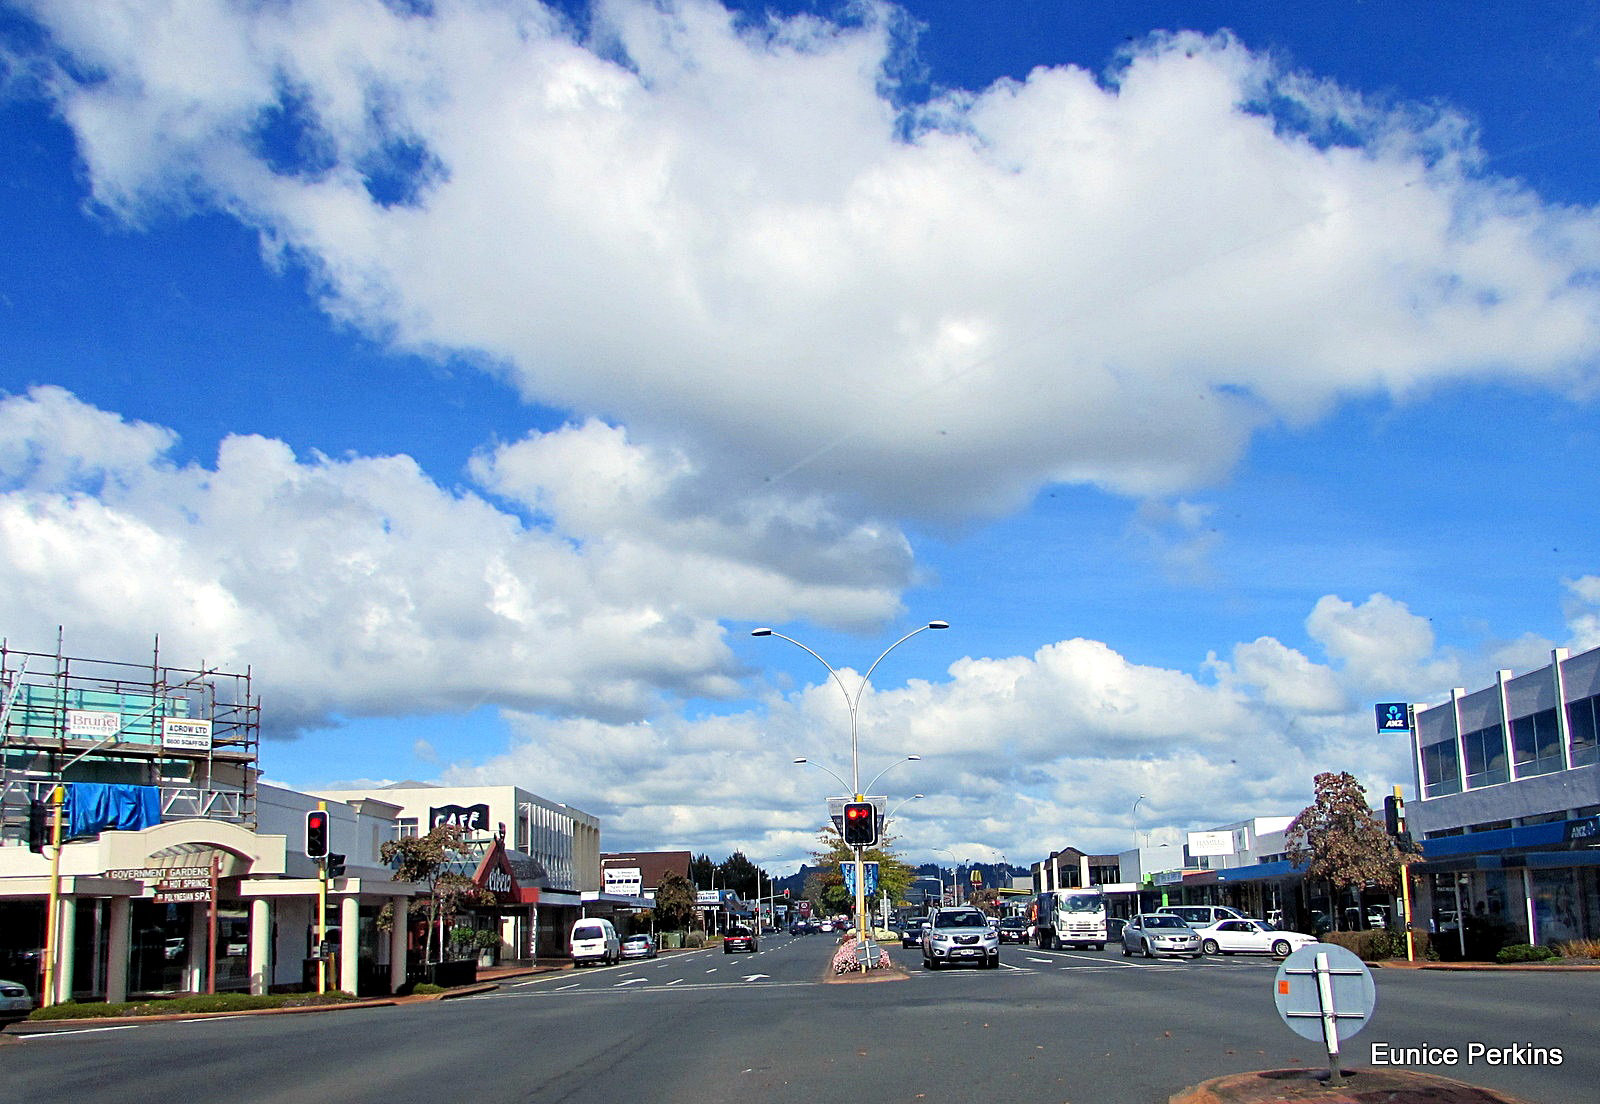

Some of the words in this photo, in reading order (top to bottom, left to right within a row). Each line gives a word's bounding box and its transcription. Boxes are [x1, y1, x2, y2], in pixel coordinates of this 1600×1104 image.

[73, 715, 118, 727] Brunel
[169, 724, 194, 733] ACROW
[195, 726, 208, 734] LTD
[1571, 826, 1587, 838] ANZ
[112, 868, 166, 878] GOVERNMENT
[170, 867, 209, 877] GARDENS
[169, 880, 181, 888] HOT
[183, 879, 209, 887] SPRINGS
[194, 891, 210, 900] SPA
